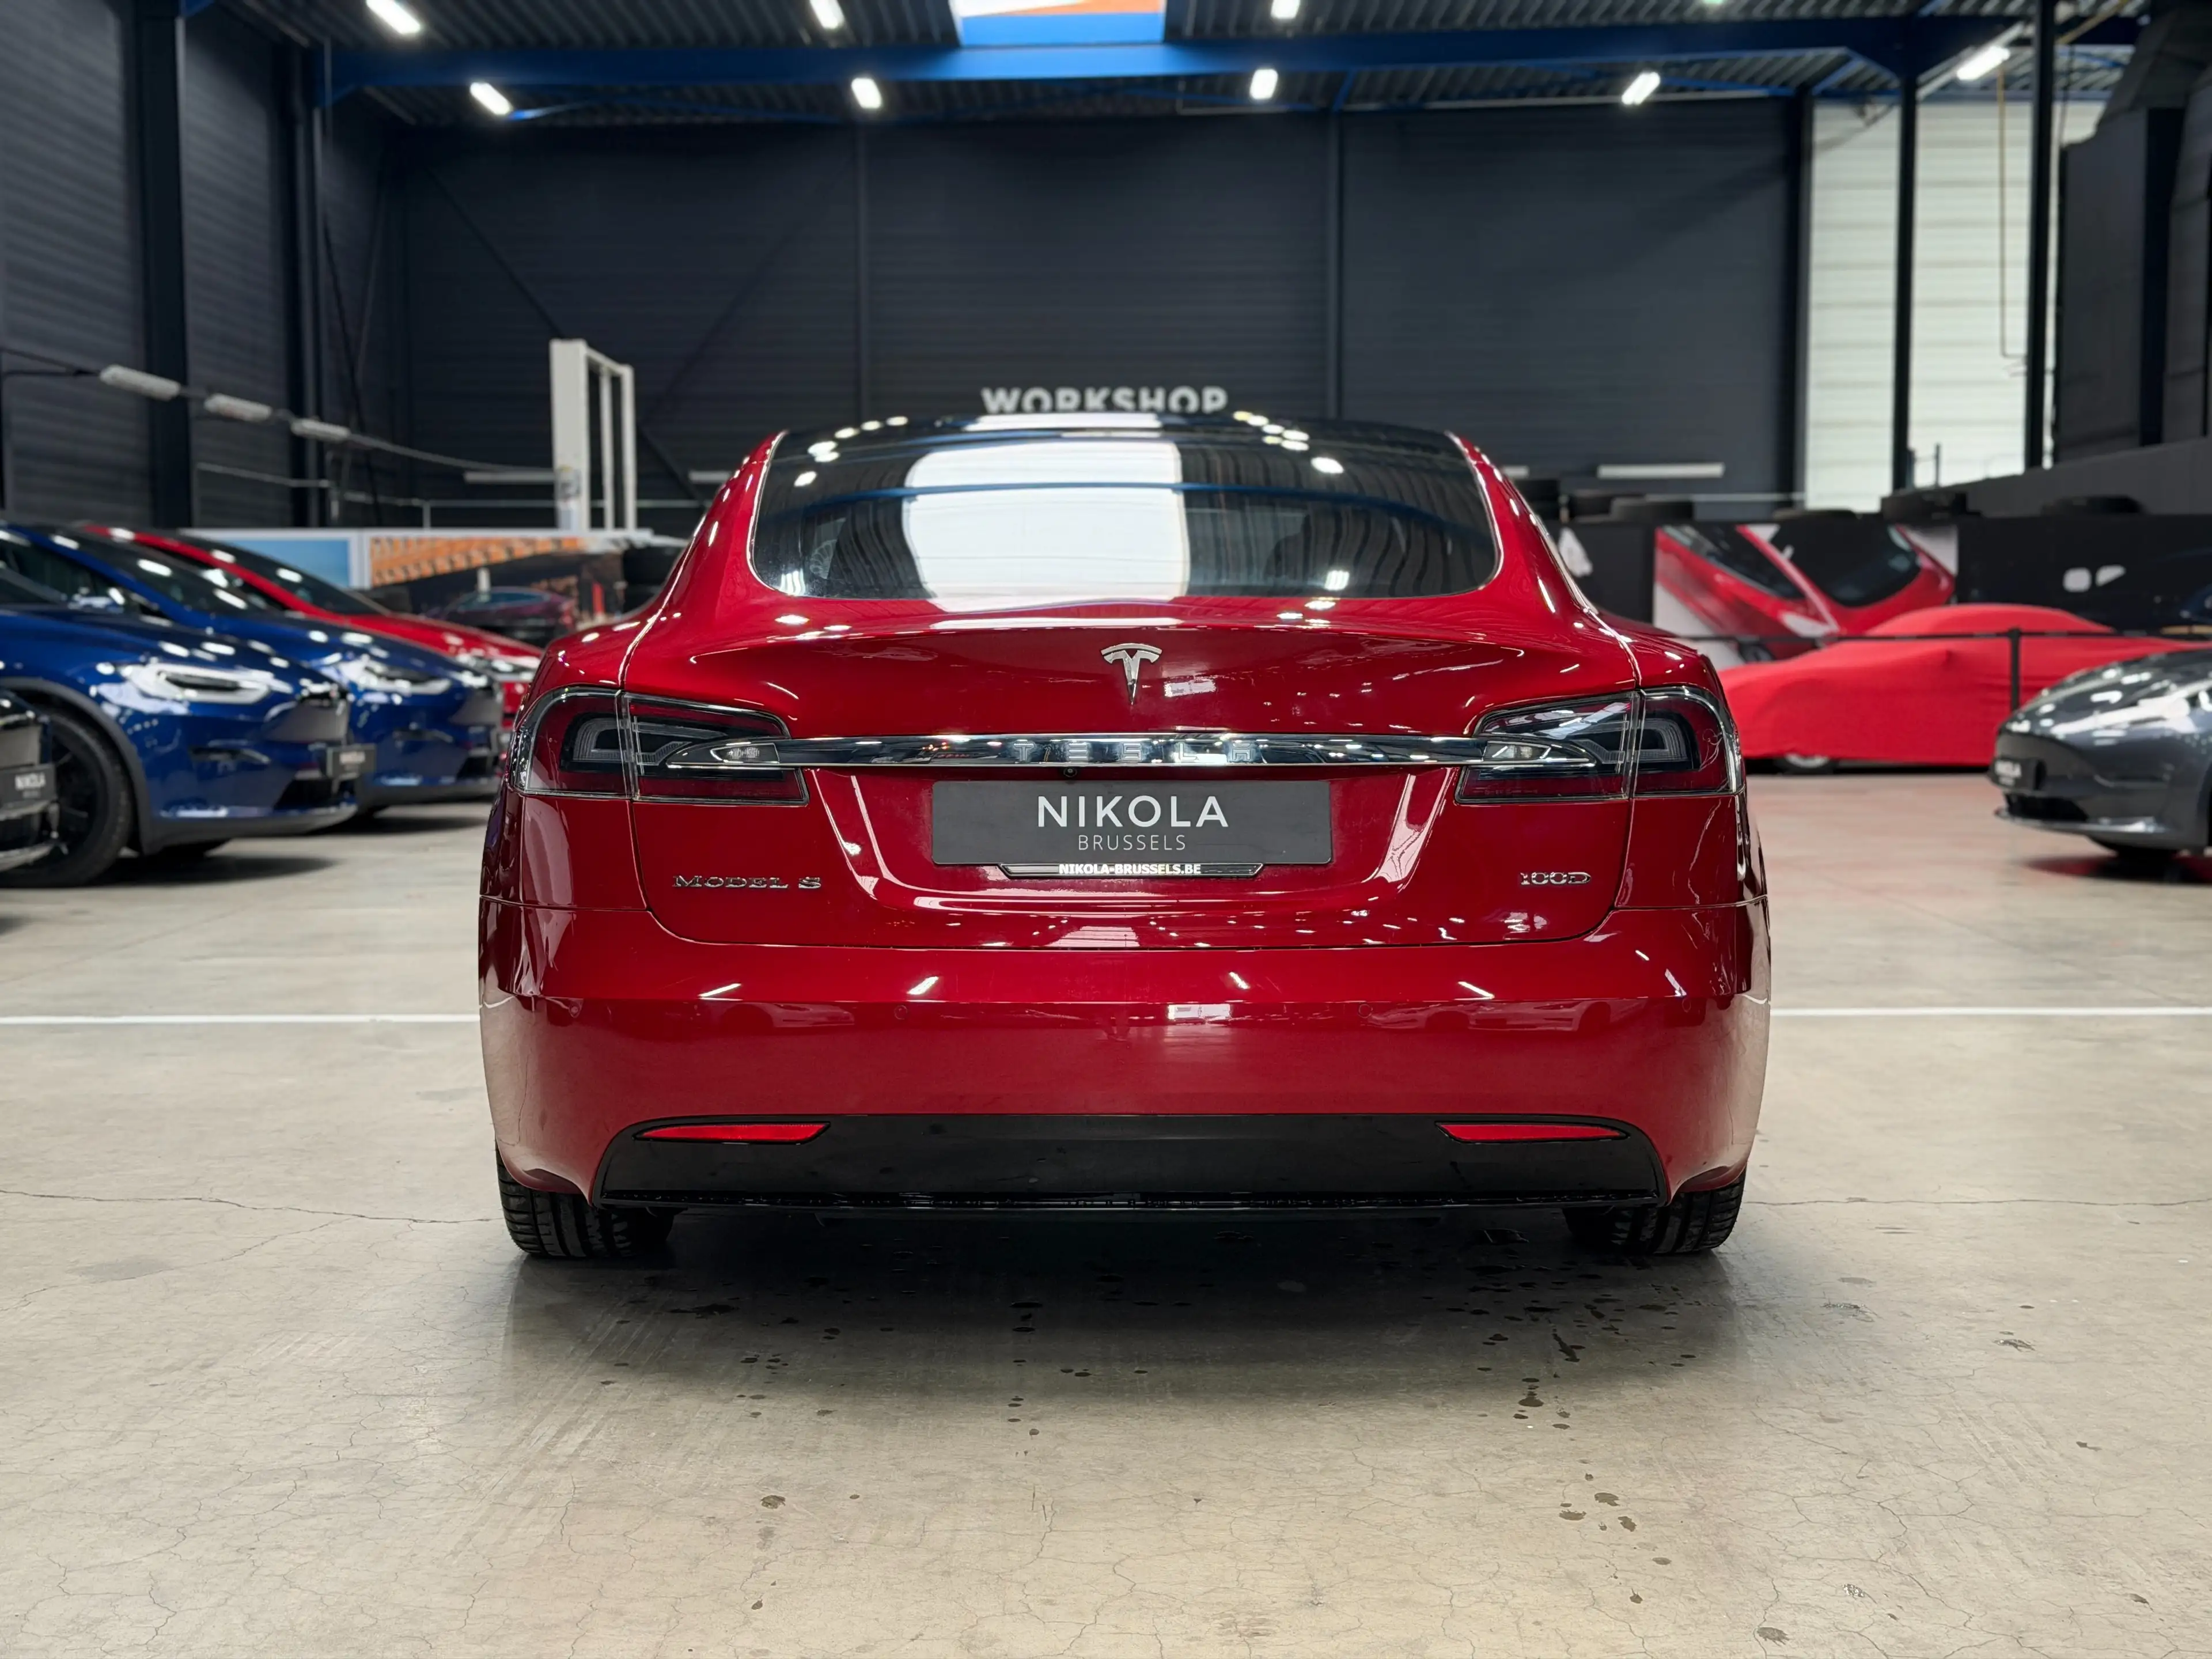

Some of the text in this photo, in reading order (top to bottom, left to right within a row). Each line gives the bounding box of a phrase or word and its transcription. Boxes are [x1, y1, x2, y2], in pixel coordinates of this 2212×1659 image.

[981, 387, 1228, 414] WORKSHOP
[1013, 742, 1251, 762] TESLA
[1038, 796, 1229, 827] NIKOLA
[1078, 835, 1185, 851] BRUSSELS
[1059, 863, 1201, 874] NIKOLA-BRUSSELS.BE
[672, 875, 821, 889] MODEL S
[1520, 872, 1591, 885] 100D
